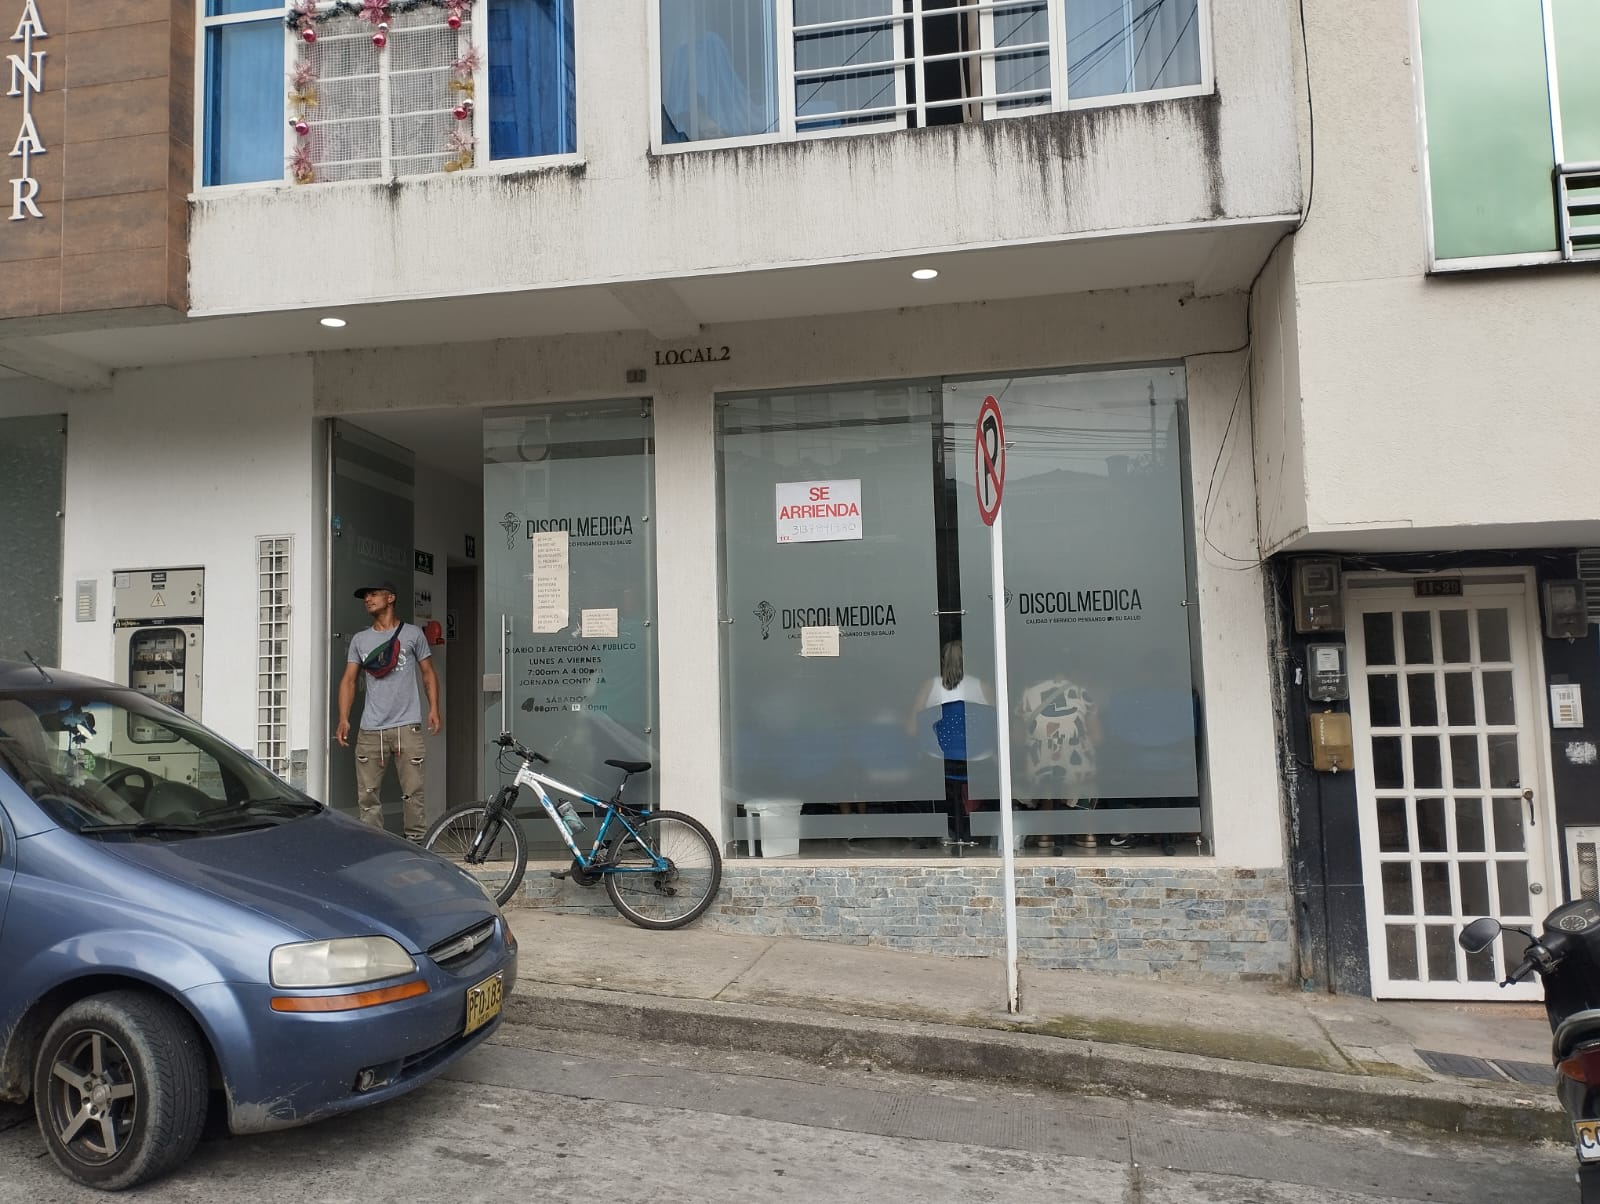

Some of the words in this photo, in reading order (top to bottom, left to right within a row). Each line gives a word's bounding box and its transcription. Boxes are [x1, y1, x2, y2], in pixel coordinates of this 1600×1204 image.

[655, 347, 717, 366] LOCAL
[719, 345, 731, 361] 2
[809, 486, 830, 502] SE
[779, 502, 860, 520] ARRIENDA
[1019, 588, 1142, 615] DISCOLMEDICA
[782, 604, 896, 630] DISCOLMEDICA
[529, 658, 555, 666] LUNES
